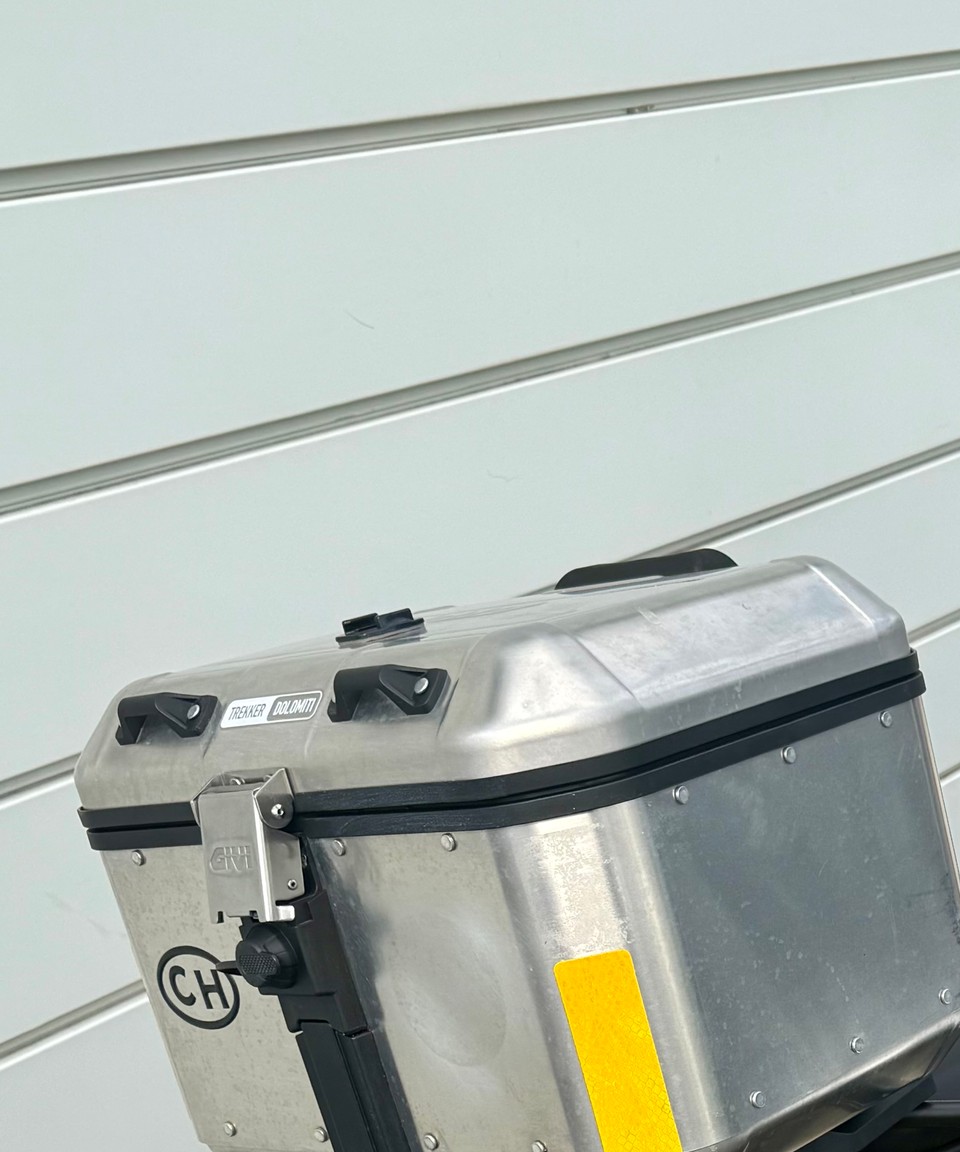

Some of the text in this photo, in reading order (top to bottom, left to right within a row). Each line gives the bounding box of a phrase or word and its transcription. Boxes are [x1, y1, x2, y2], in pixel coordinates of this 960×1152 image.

[228, 697, 317, 720] TREKKER DOLOMITI
[169, 965, 230, 1010] CH
